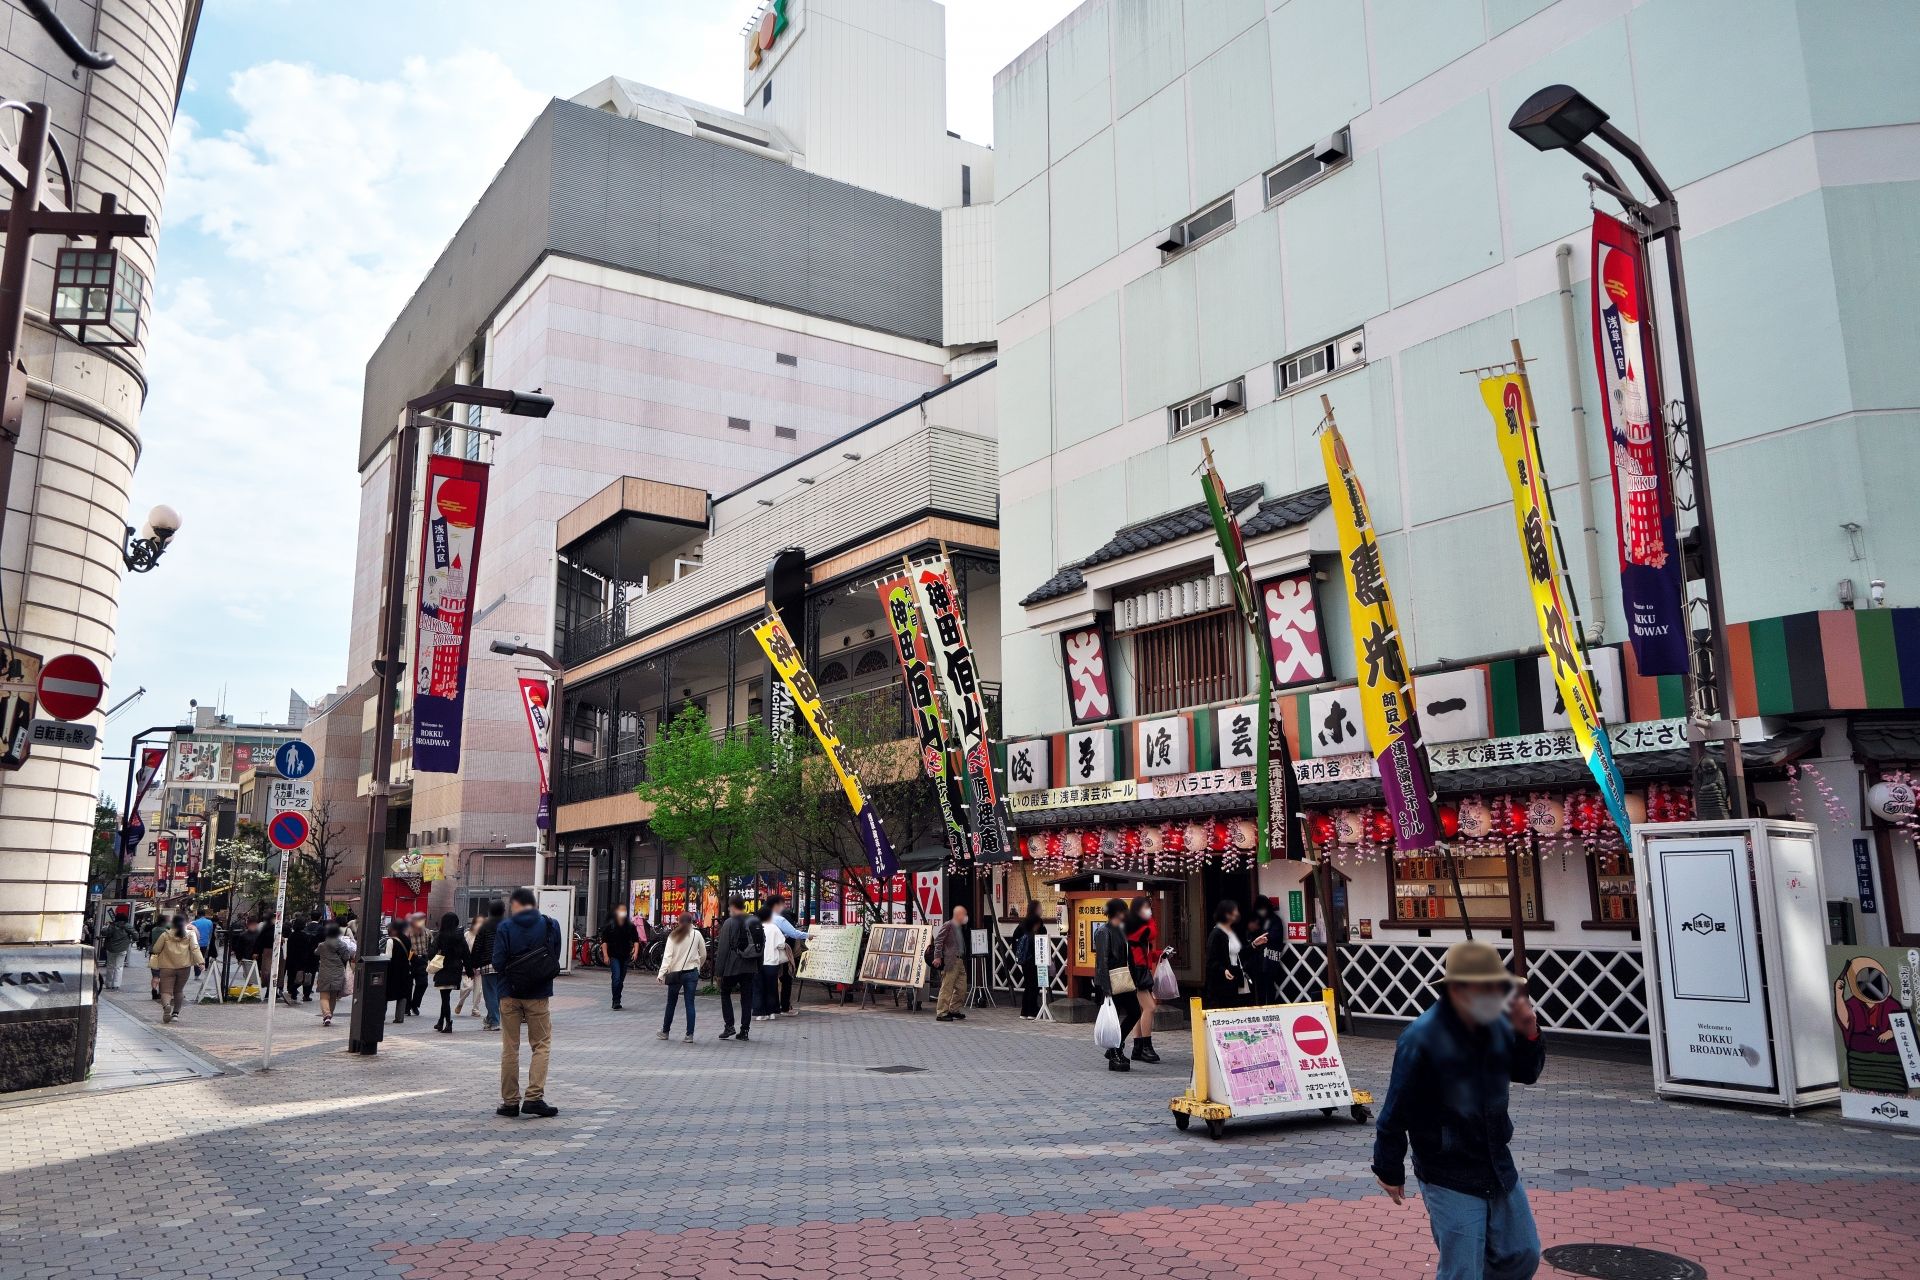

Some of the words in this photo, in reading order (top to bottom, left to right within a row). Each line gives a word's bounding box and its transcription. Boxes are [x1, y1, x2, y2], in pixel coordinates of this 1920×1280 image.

[1608, 315, 1625, 370] 浅草六区
[1627, 475, 1658, 492] OKKU
[434, 524, 447, 563] 浅草六区
[1265, 579, 1325, 684] 大入
[1066, 631, 1111, 719] 大入
[34, 725, 90, 744] 自転車を除く
[420, 729, 444, 738] ROKKU
[416, 737, 451, 747] BROADWAY
[274, 790, 293, 798] 人力車
[275, 783, 293, 791] 自転車
[1391, 741, 1424, 835] 浅草演芸ホール
[1010, 784, 1134, 808] いの殿堂！浅草演芸ホール
[1858, 855, 1870, 895] 浅草一丁目
[1862, 900, 1874, 909] 43
[1698, 1022, 1724, 1030] Welcome
[1698, 1033, 1733, 1045] ROKKU
[1690, 1044, 1745, 1057] BROADWAY
[1299, 1056, 1340, 1071] 進入禁止
